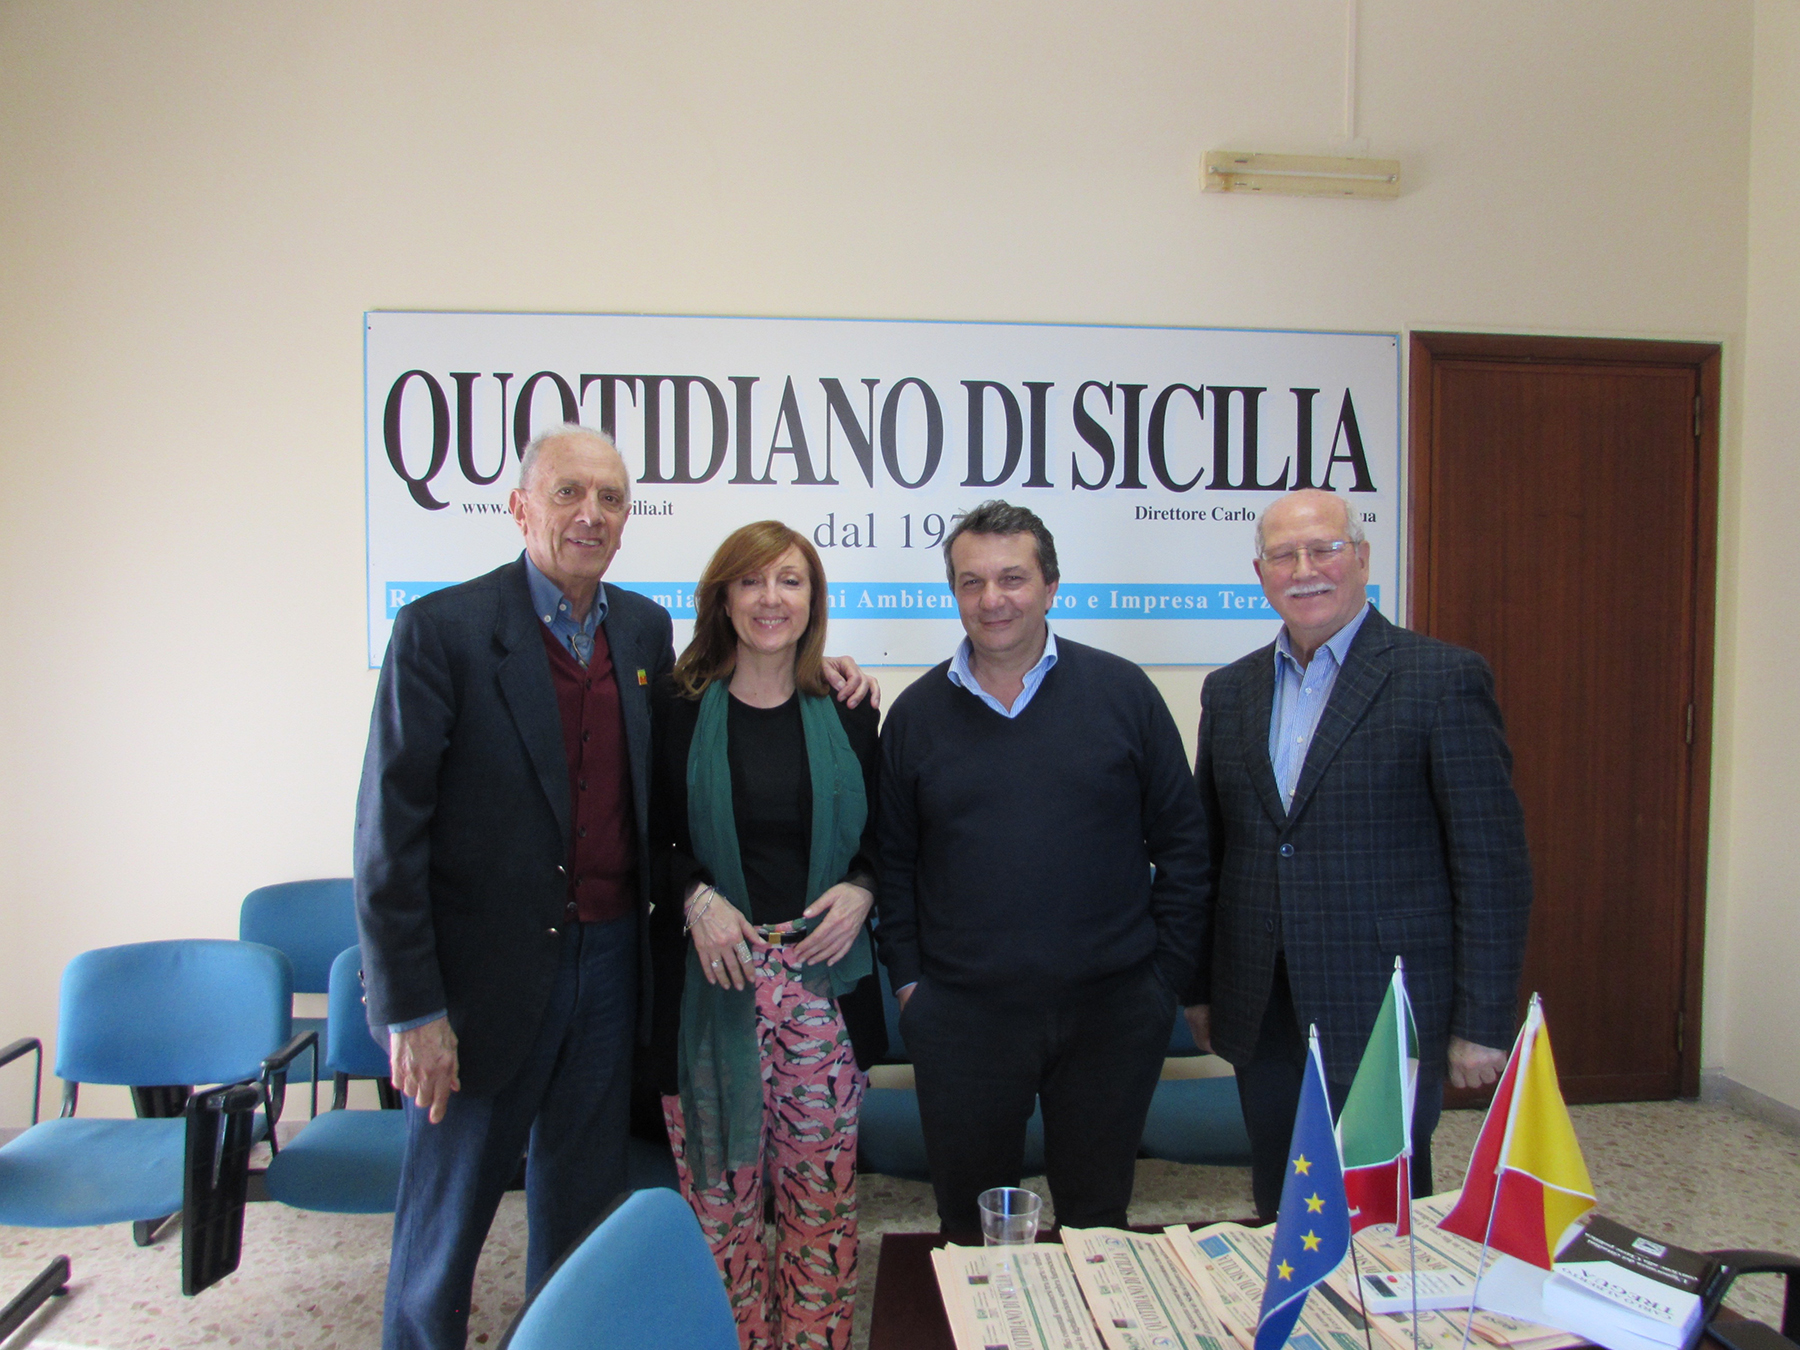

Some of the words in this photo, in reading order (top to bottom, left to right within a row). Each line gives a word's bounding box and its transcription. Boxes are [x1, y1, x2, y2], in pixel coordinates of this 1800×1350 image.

[383, 369, 944, 510] QUOTIDIANO
[960, 380, 1055, 488] DI
[1071, 380, 1377, 493] SICILIA
[813, 512, 878, 549] dal
[1135, 505, 1206, 521] Direttore
[1211, 506, 1256, 522] Carlo
[857, 589, 954, 609] Ambien
[1087, 595, 1099, 609] e
[1110, 590, 1209, 613] Impresa
[1218, 591, 1271, 610] Terz
[1580, 1268, 1673, 1315] TREGUA
